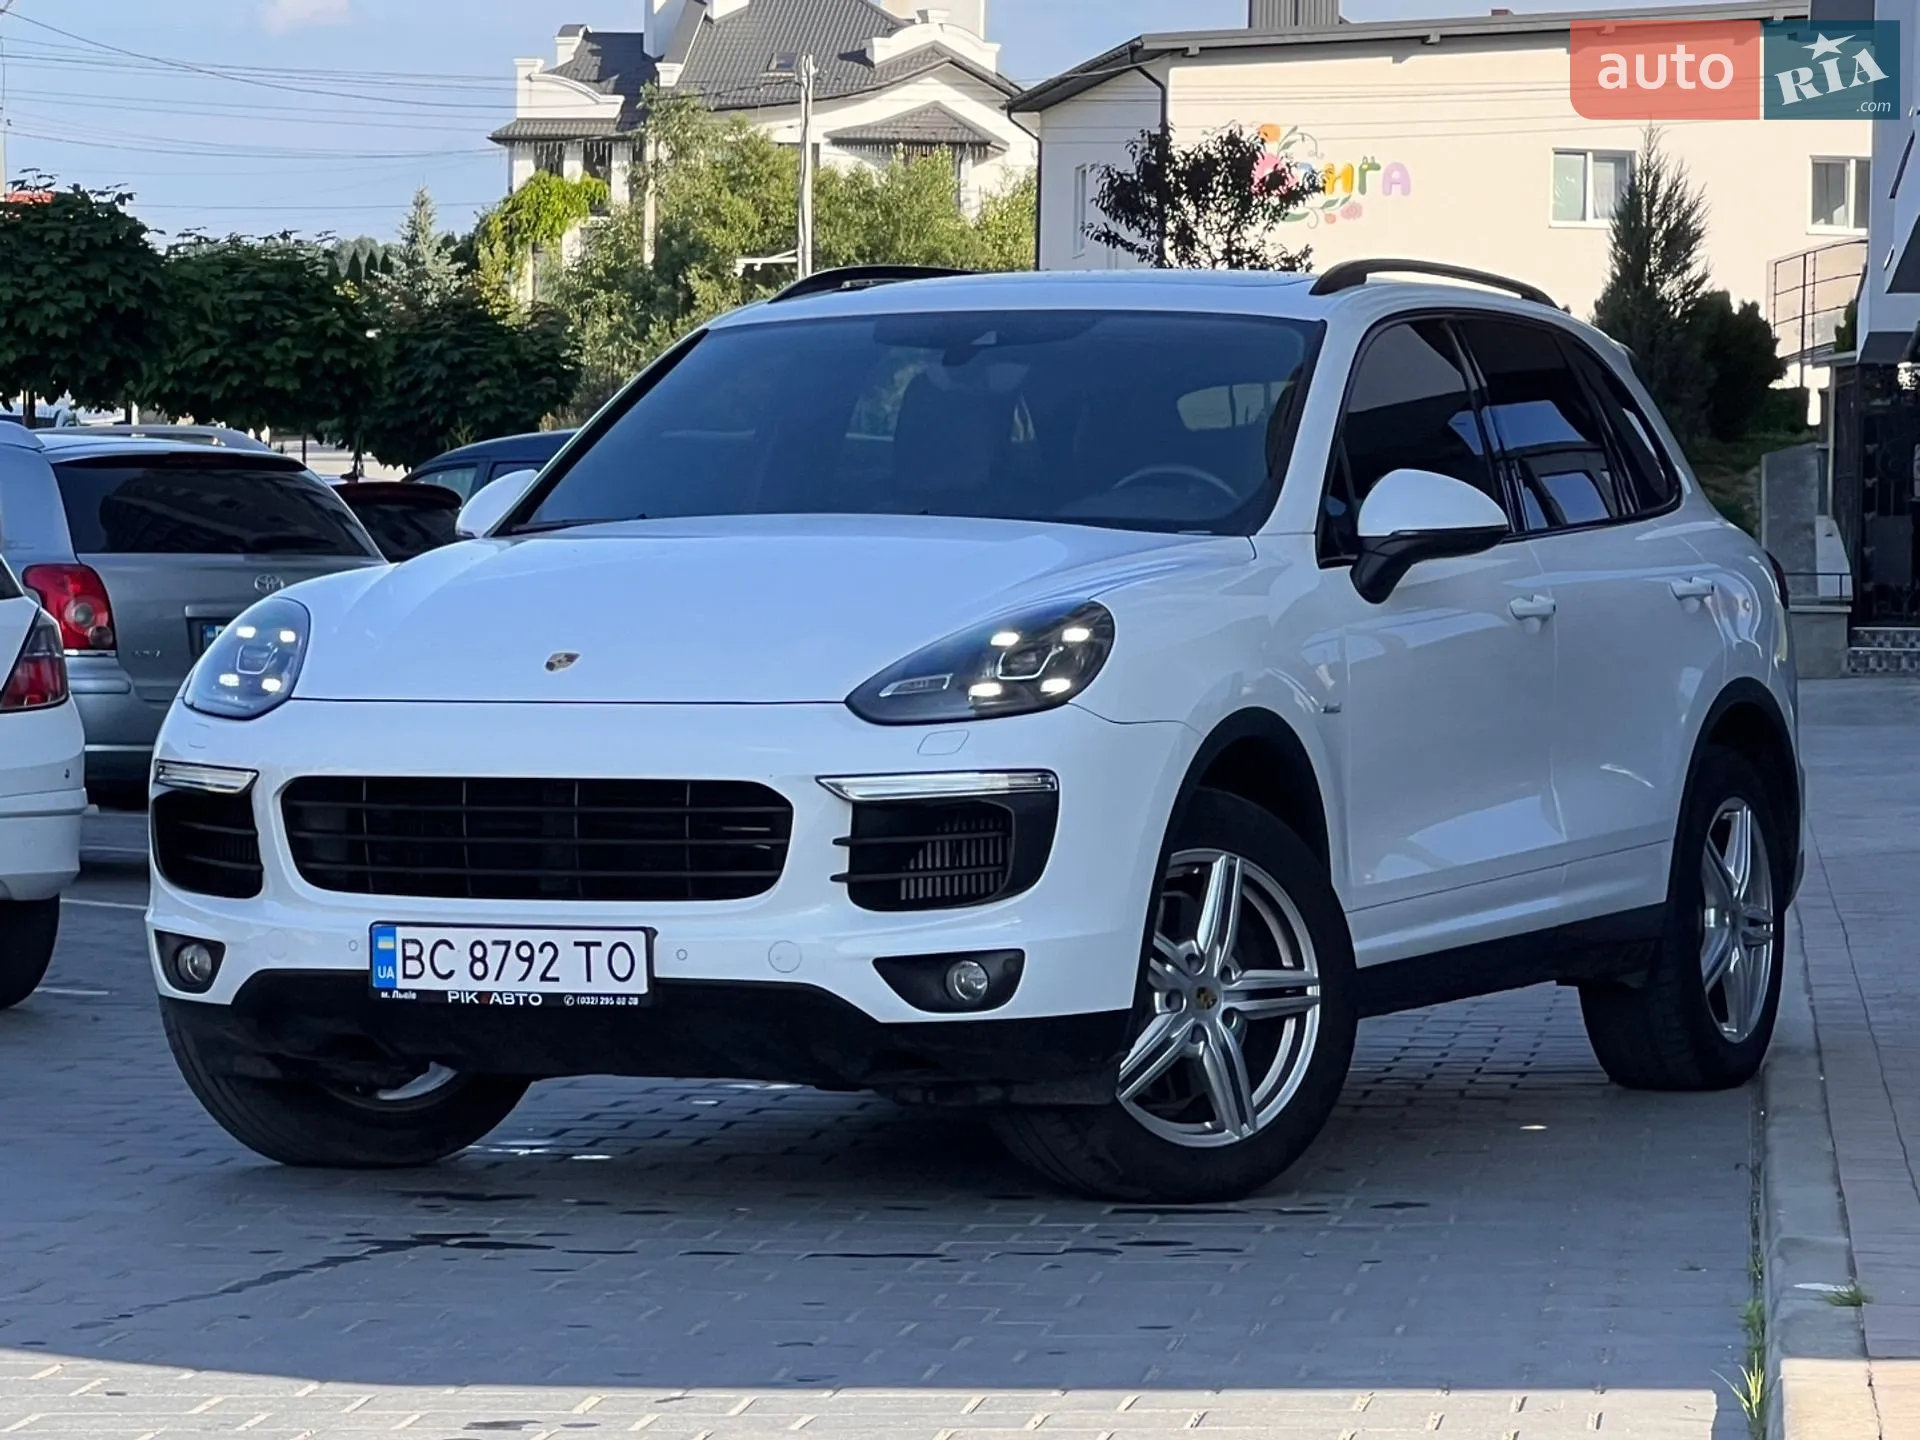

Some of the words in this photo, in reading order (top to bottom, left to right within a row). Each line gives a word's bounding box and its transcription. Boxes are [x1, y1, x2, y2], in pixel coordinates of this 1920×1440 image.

[377, 966, 395, 978] UA
[402, 938, 456, 980] BC
[469, 939, 560, 983] 8792
[573, 940, 636, 983] TO
